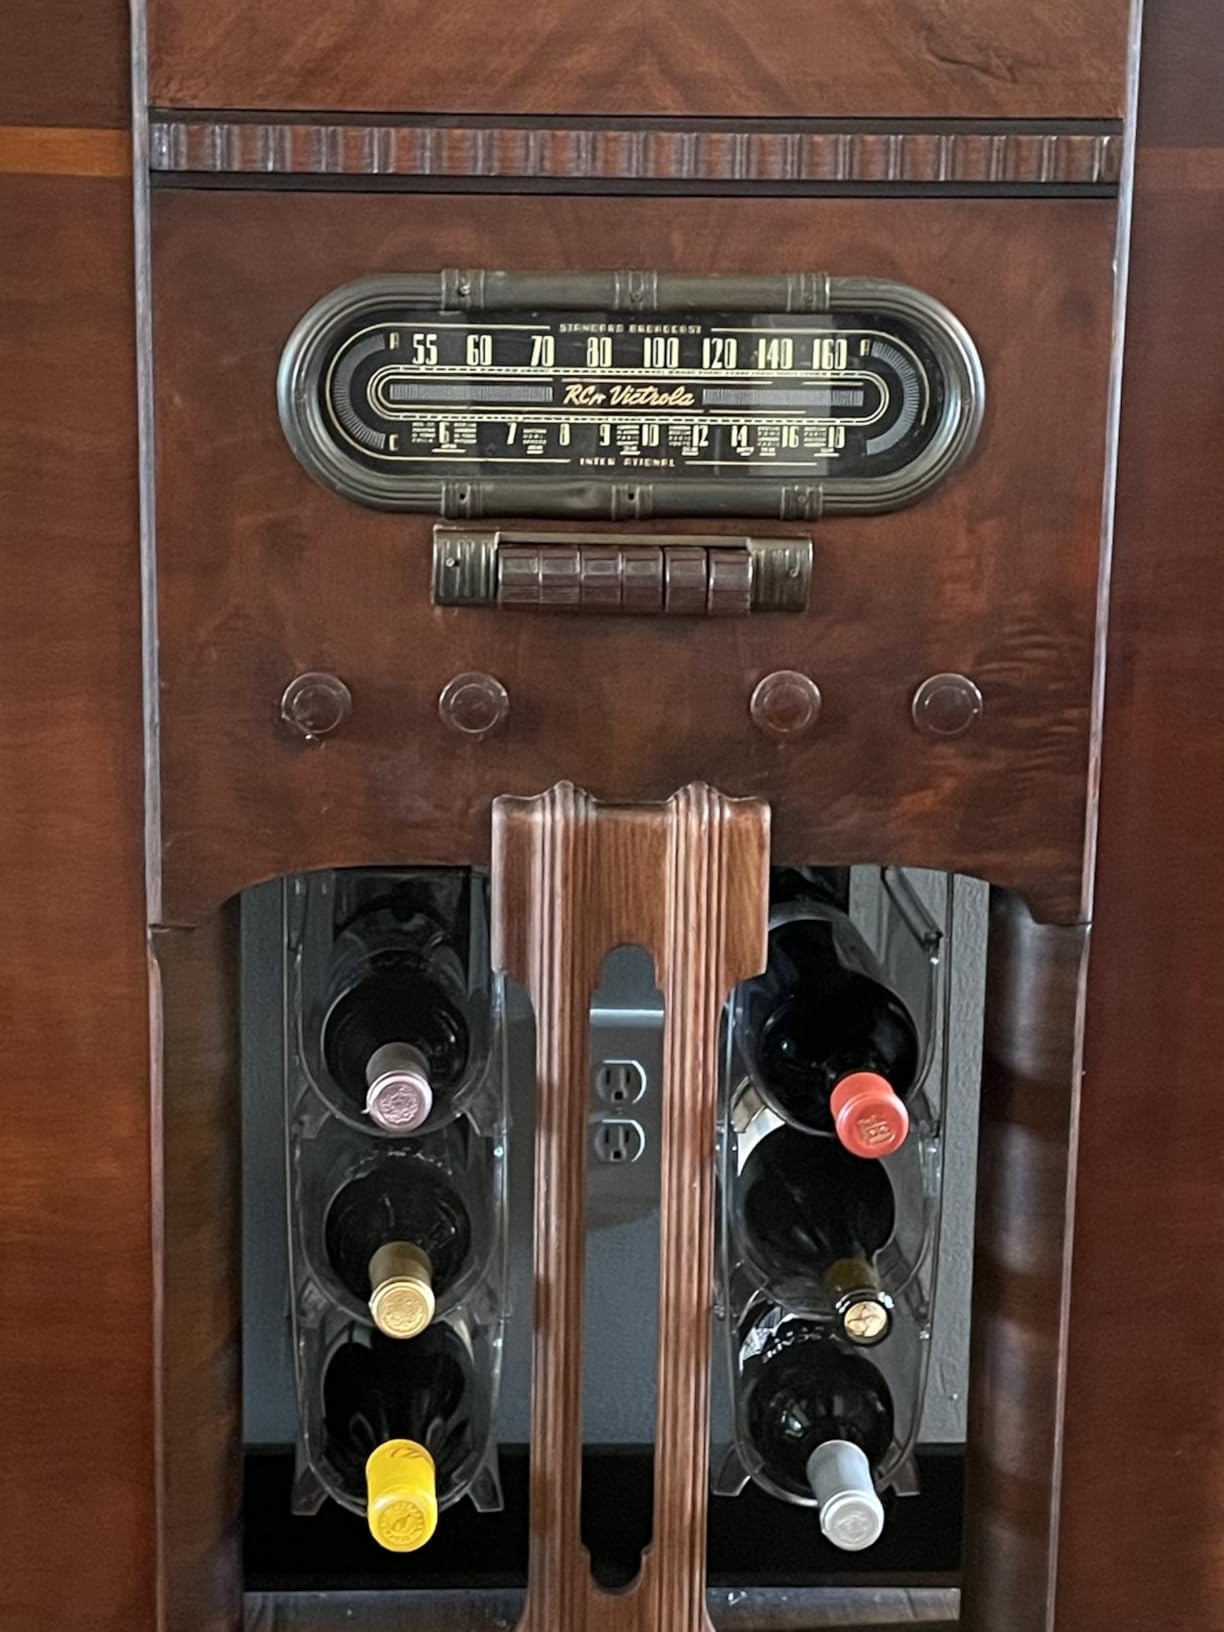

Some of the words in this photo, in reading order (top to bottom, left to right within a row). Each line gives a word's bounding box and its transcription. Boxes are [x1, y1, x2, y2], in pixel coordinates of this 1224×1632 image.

[412, 333, 438, 365] 55
[466, 334, 493, 366] 60
[530, 335, 555, 367] 70
[586, 336, 612, 368] 80
[643, 337, 679, 368] 100
[702, 338, 737, 369] 120
[757, 338, 793, 370] 140
[812, 338, 848, 370] 160
[563, 384, 606, 405] RCA
[609, 385, 695, 406] Victrola
[439, 422, 450, 444] 6
[506, 422, 517, 445] 7
[600, 424, 611, 446] 9
[642, 424, 660, 447] 10
[692, 424, 709, 447] 12
[731, 425, 748, 448] 14
[782, 425, 800, 448] 16
